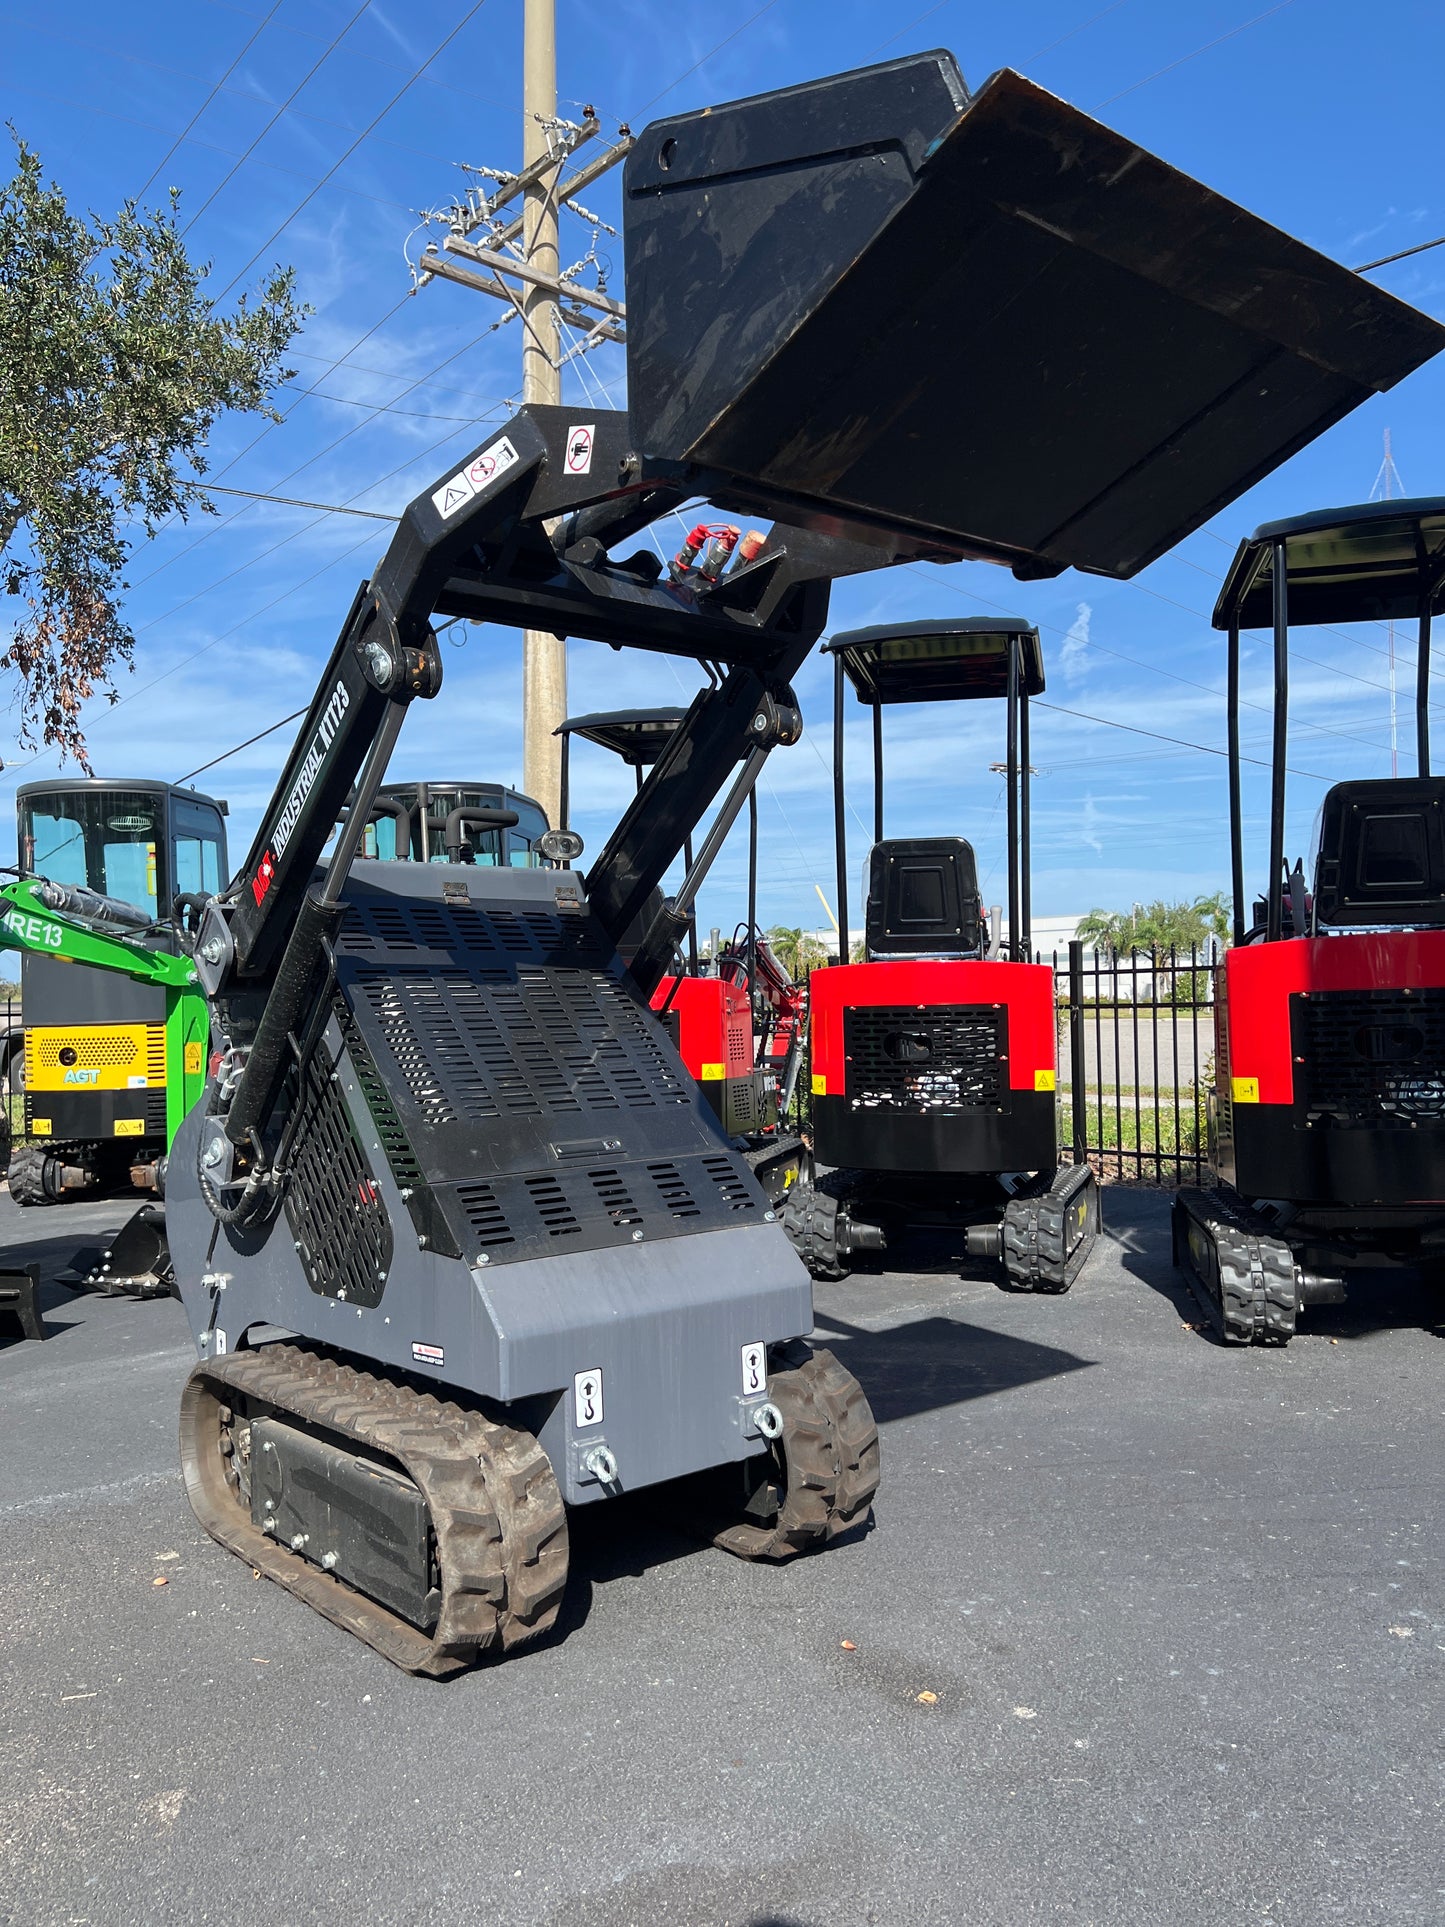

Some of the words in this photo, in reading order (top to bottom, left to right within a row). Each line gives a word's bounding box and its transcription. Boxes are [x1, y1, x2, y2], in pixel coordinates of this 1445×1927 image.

[252, 850, 275, 908] AGT
[272, 745, 324, 856] INDUSTRIAL
[64, 1069, 101, 1084] AGT
